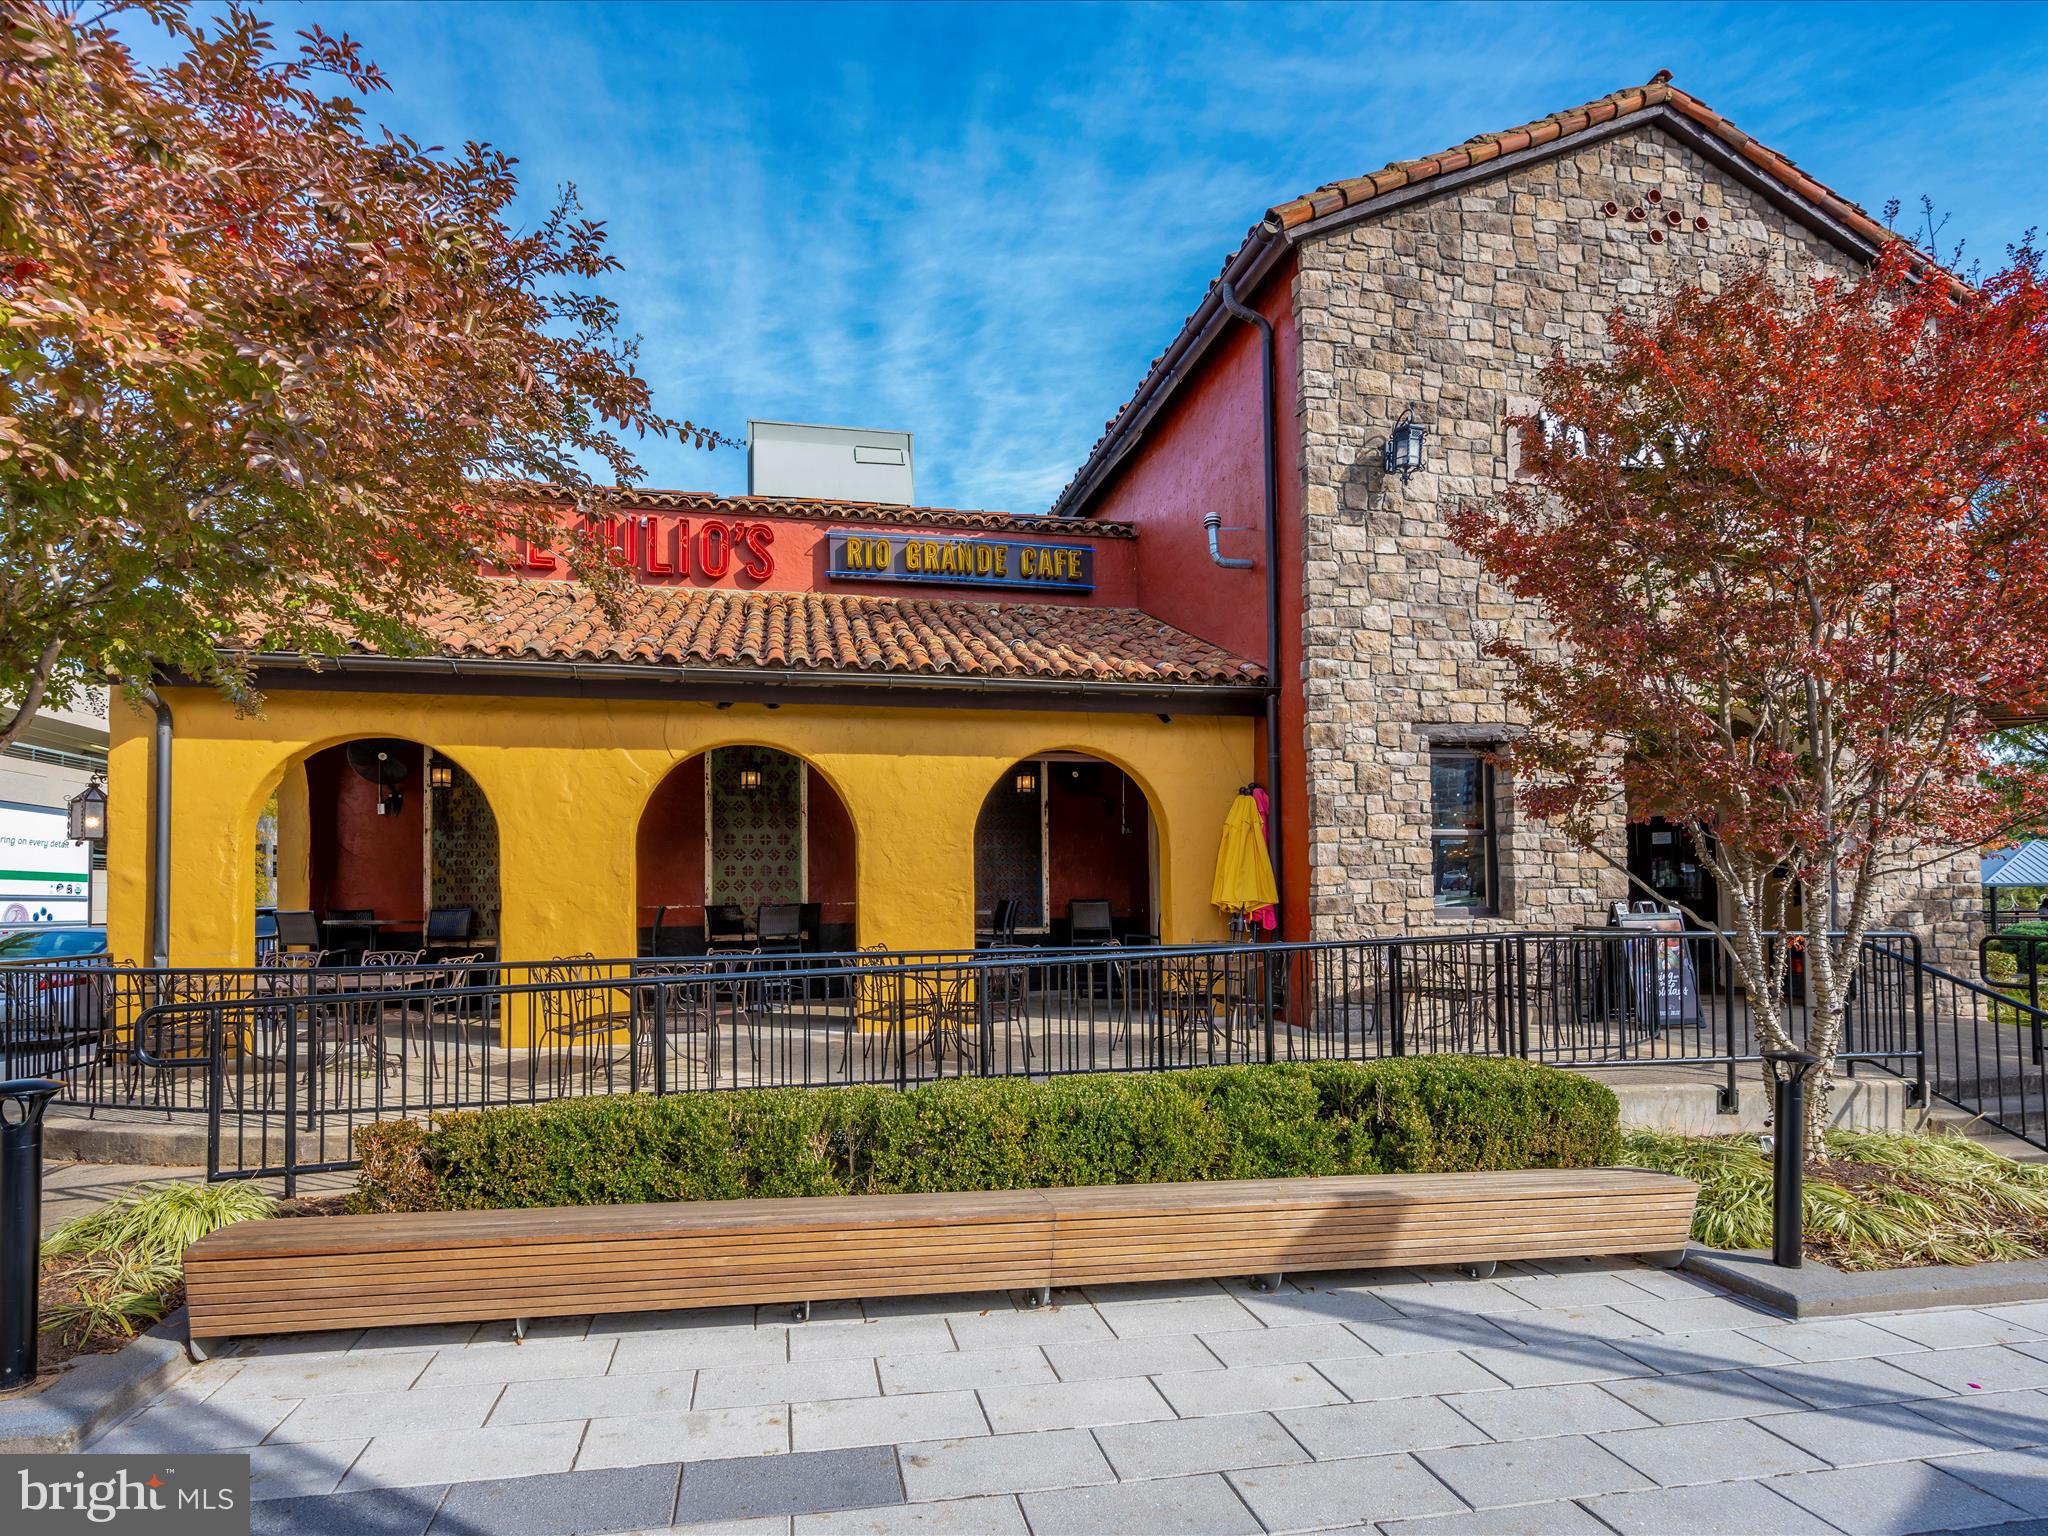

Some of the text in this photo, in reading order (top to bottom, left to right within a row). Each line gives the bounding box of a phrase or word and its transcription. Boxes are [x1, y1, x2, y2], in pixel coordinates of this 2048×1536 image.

[847, 536, 1083, 580] RIO GRANDE CAFE
[29, 839, 48, 848] every
